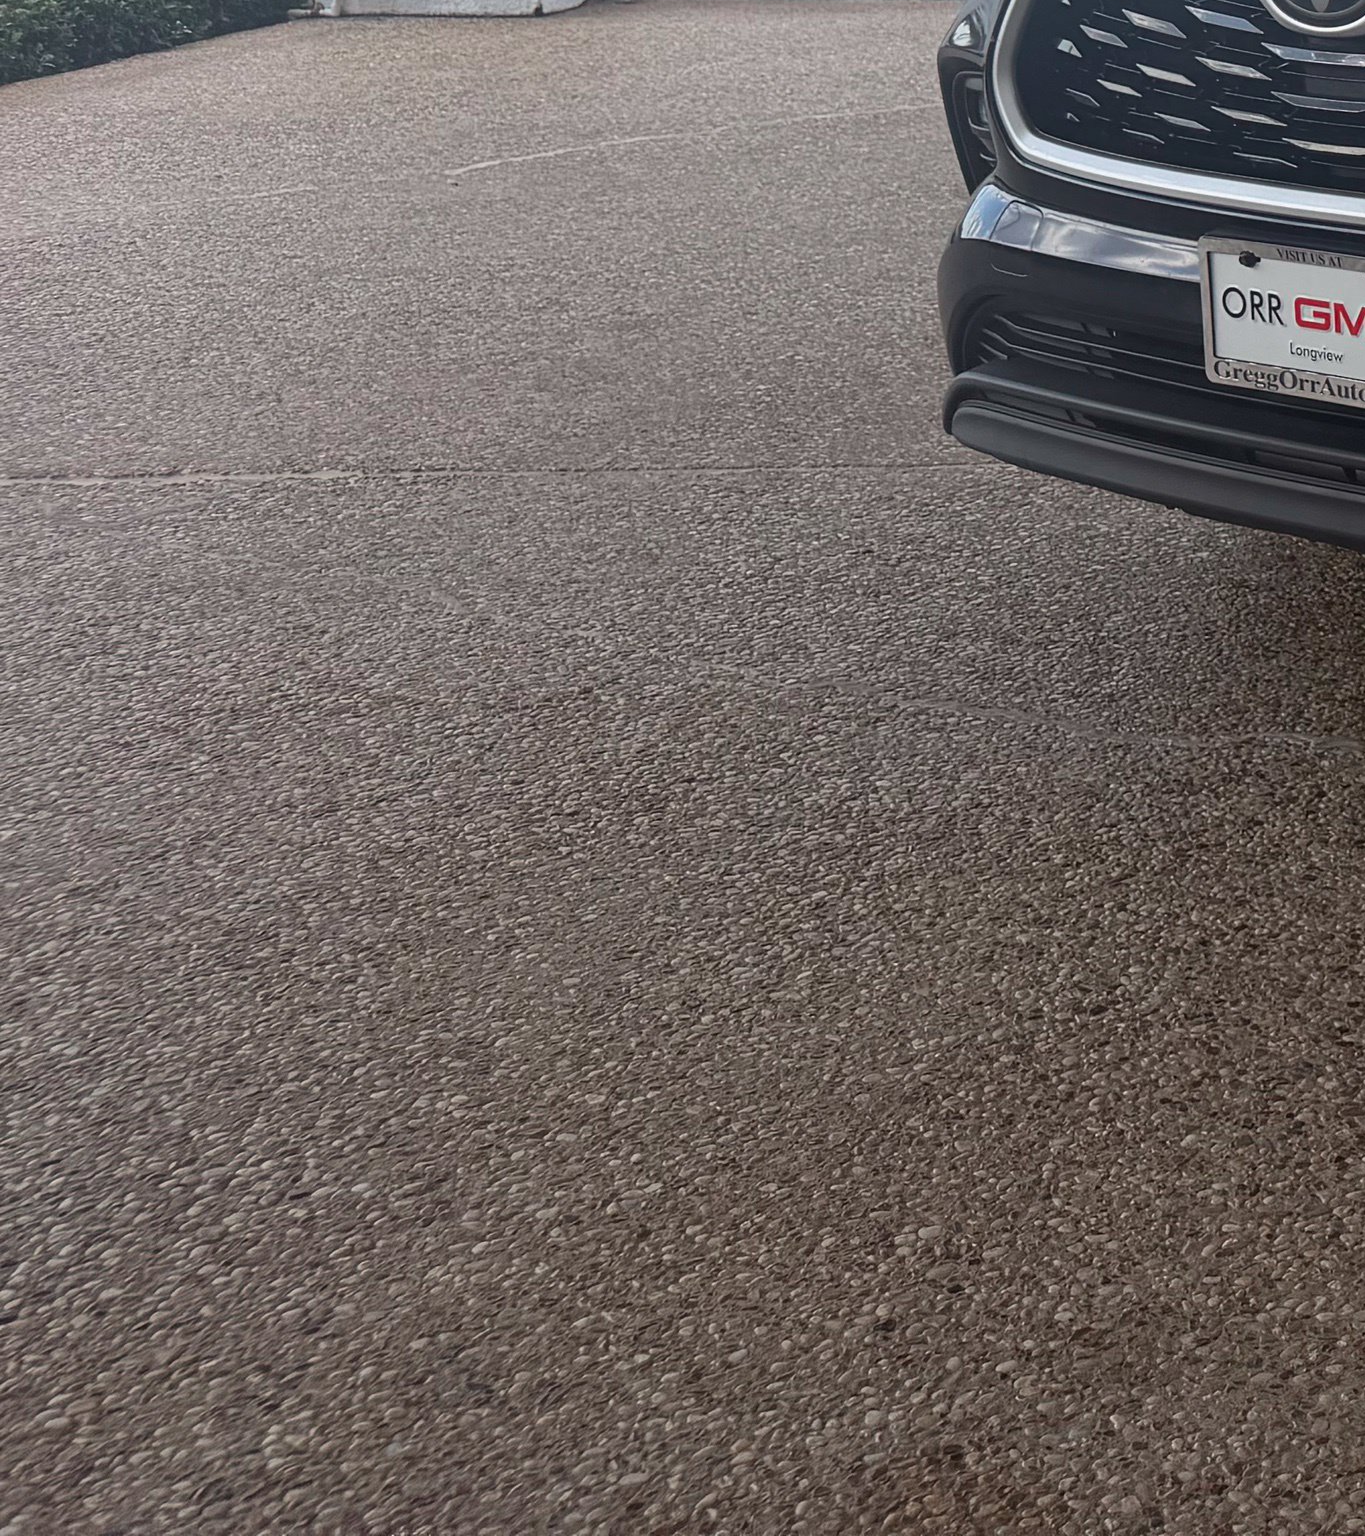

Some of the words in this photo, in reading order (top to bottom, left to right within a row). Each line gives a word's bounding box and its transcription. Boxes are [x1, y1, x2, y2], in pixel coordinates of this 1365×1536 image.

[1276, 248, 1308, 264] VISIT
[1310, 252, 1327, 266] US
[1328, 256, 1344, 268] AT
[1221, 286, 1285, 326] ORR
[1289, 341, 1344, 364] Longview
